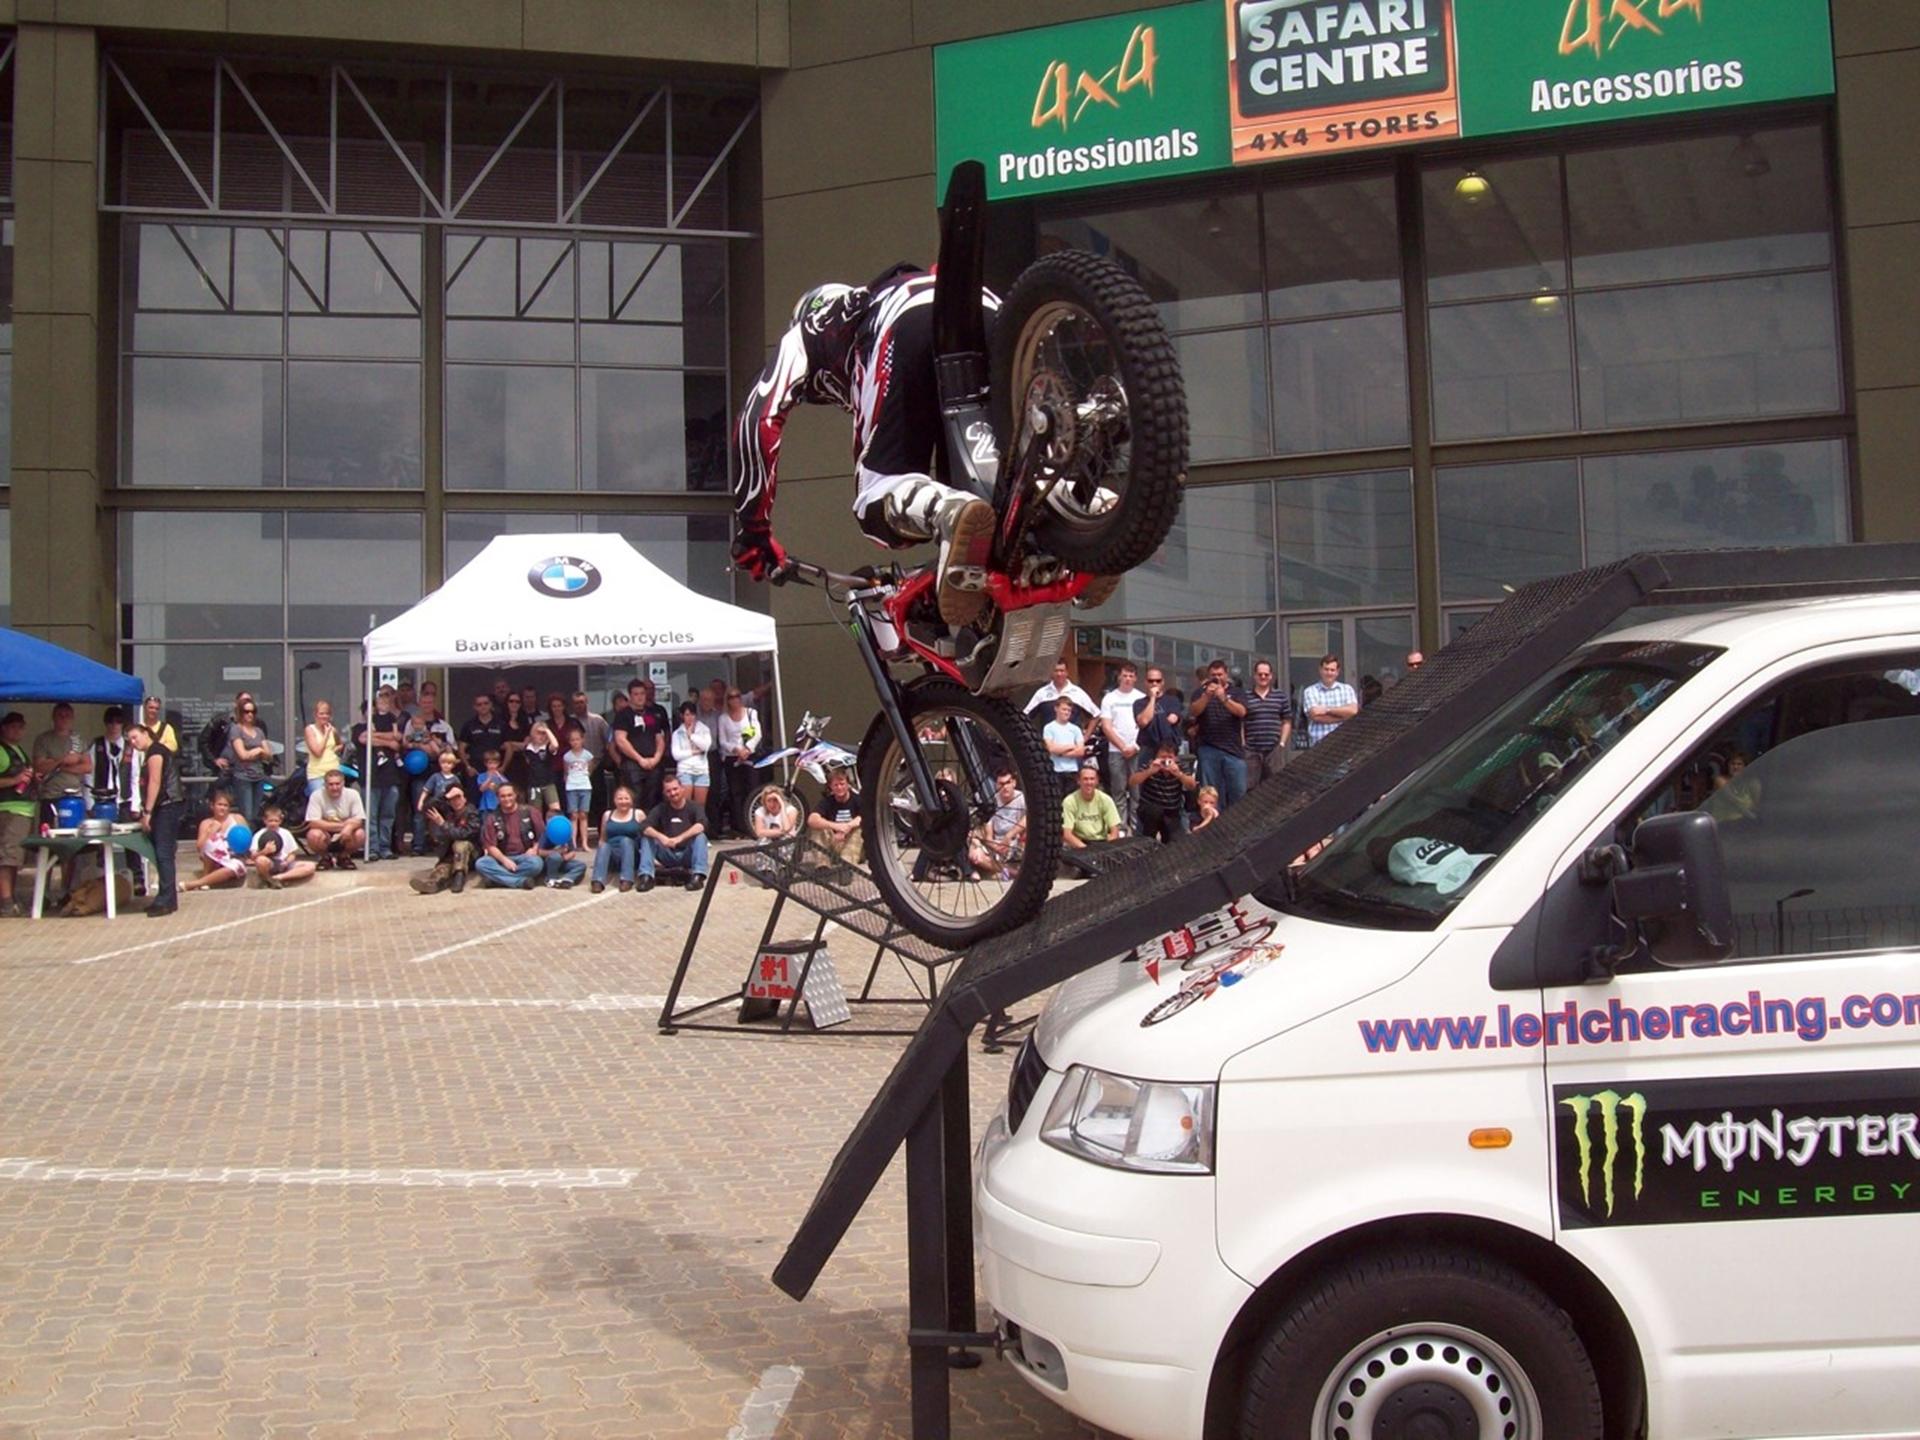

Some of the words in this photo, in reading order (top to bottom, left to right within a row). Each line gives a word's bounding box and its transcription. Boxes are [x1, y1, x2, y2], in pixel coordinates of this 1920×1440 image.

[1248, 0, 1426, 52] SAFARI
[1031, 24, 1158, 133] 4x4
[1249, 37, 1429, 96] CENTRE
[1530, 60, 1744, 112] Accessories
[999, 129, 1199, 183] Professionals
[1250, 128, 1310, 151] 4X4
[1325, 111, 1440, 143] STORES
[455, 634, 534, 652] Bavarian
[540, 634, 579, 648] East
[585, 631, 695, 648] Motorcycles
[760, 955, 788, 981] #1
[1659, 1108, 1920, 1172] MONSTER
[1701, 1183, 1911, 1207] ENERGY
